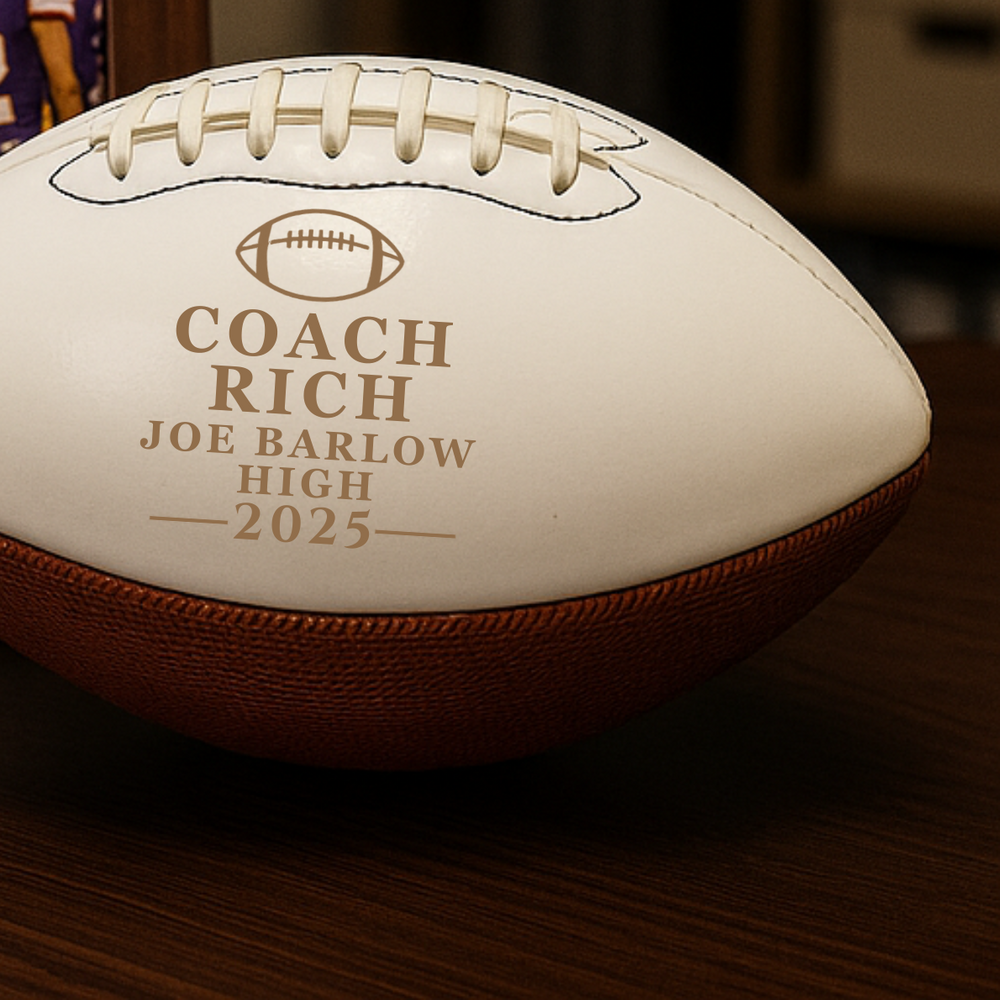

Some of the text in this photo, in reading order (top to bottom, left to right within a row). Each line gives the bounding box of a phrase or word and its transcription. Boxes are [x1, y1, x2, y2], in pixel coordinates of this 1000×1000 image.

[175, 305, 454, 368] COACH
[208, 364, 413, 423] RICH
[140, 420, 477, 469] JOE BARLOW
[236, 464, 374, 502] HIGH
[233, 502, 371, 549] 2025
